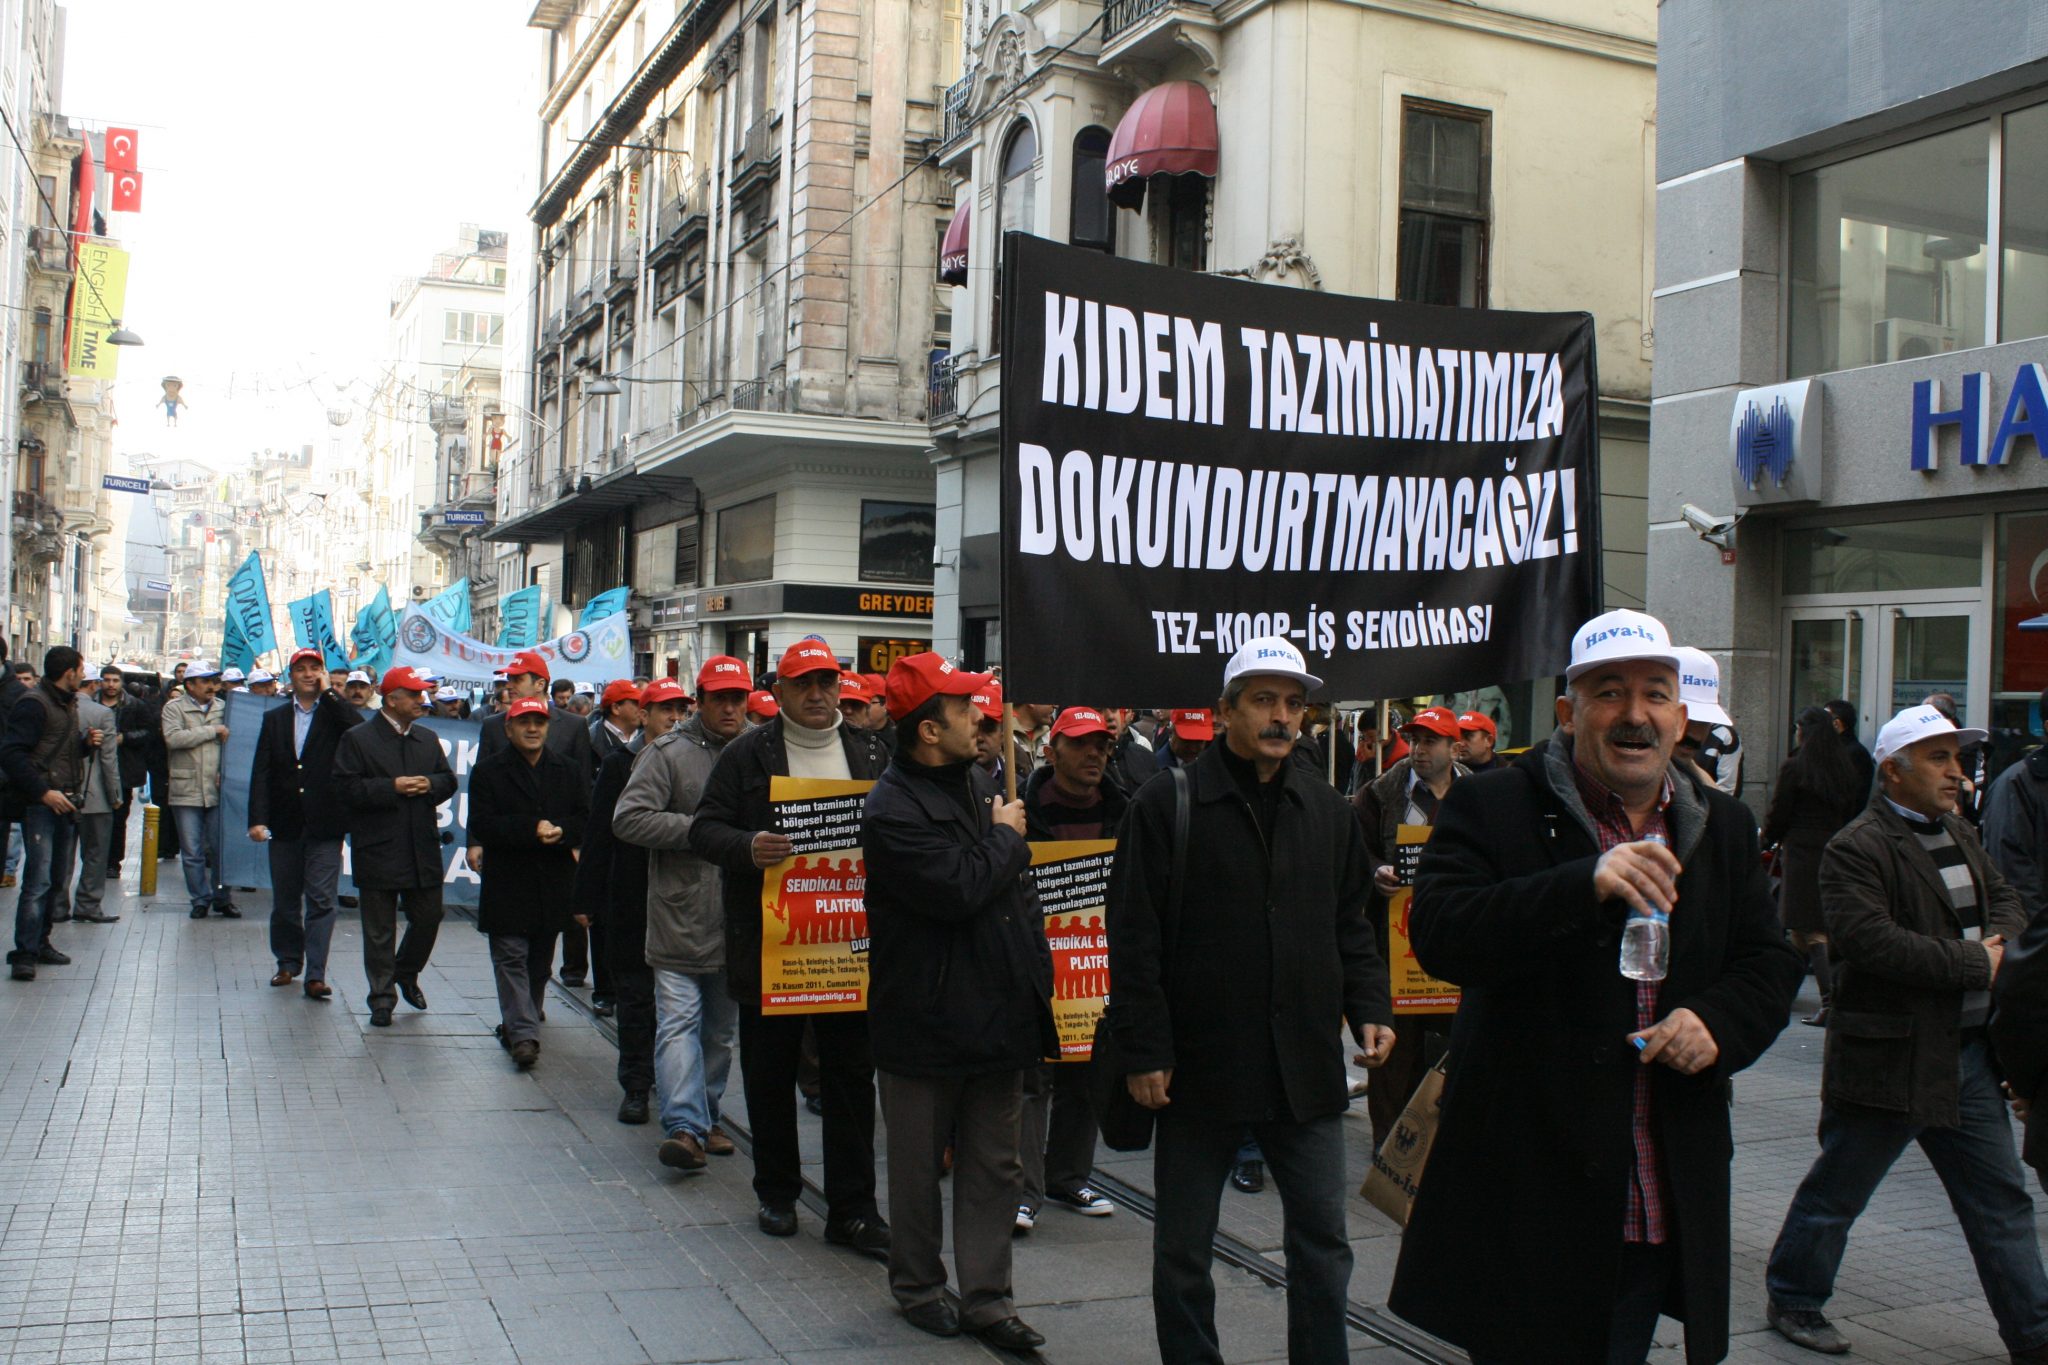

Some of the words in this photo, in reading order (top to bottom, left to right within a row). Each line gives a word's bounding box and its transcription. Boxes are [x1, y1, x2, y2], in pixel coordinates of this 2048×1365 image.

[628, 173, 639, 230] EMLAK
[87, 249, 108, 317] ENGLISH
[81, 331, 98, 369] TIME
[1042, 291, 1225, 426] KIDEM
[1241, 322, 1563, 442] TAZMİNATIMIZA
[104, 477, 148, 491] TURKCELL
[1018, 443, 1578, 572] DOKUNDURTMAYACAĞIZ!
[446, 513, 484, 522] TURKCELL
[860, 593, 934, 613] GREYDER
[1152, 604, 1336, 658] TEZ-KOOP-İŞ
[1347, 602, 1492, 649] SENDİKASI
[1919, 713, 1942, 724] Hav
[781, 804, 811, 814] kıdem
[813, 798, 856, 811] tazminatı
[783, 815, 823, 828] bölgesel
[826, 811, 854, 823] asgari
[814, 824, 860, 838] çalışmaya
[791, 837, 857, 854] şeronlaşmaya
[1036, 865, 1062, 877] kıdem
[1063, 858, 1102, 872] tazminatı
[786, 876, 842, 893] SENDİKAL
[1037, 874, 1073, 889] bölgesel
[1075, 869, 1100, 882] asgari
[1038, 889, 1063, 902] esnek
[1065, 882, 1107, 899] çalışmaya
[1043, 895, 1105, 914] aşeronlaşmaya
[1047, 934, 1094, 950] ENDİKAL
[1070, 955, 1108, 970] PLATFO
[772, 982, 781, 991] 26
[783, 982, 803, 990] Kasım
[827, 979, 861, 988] Cumartesi
